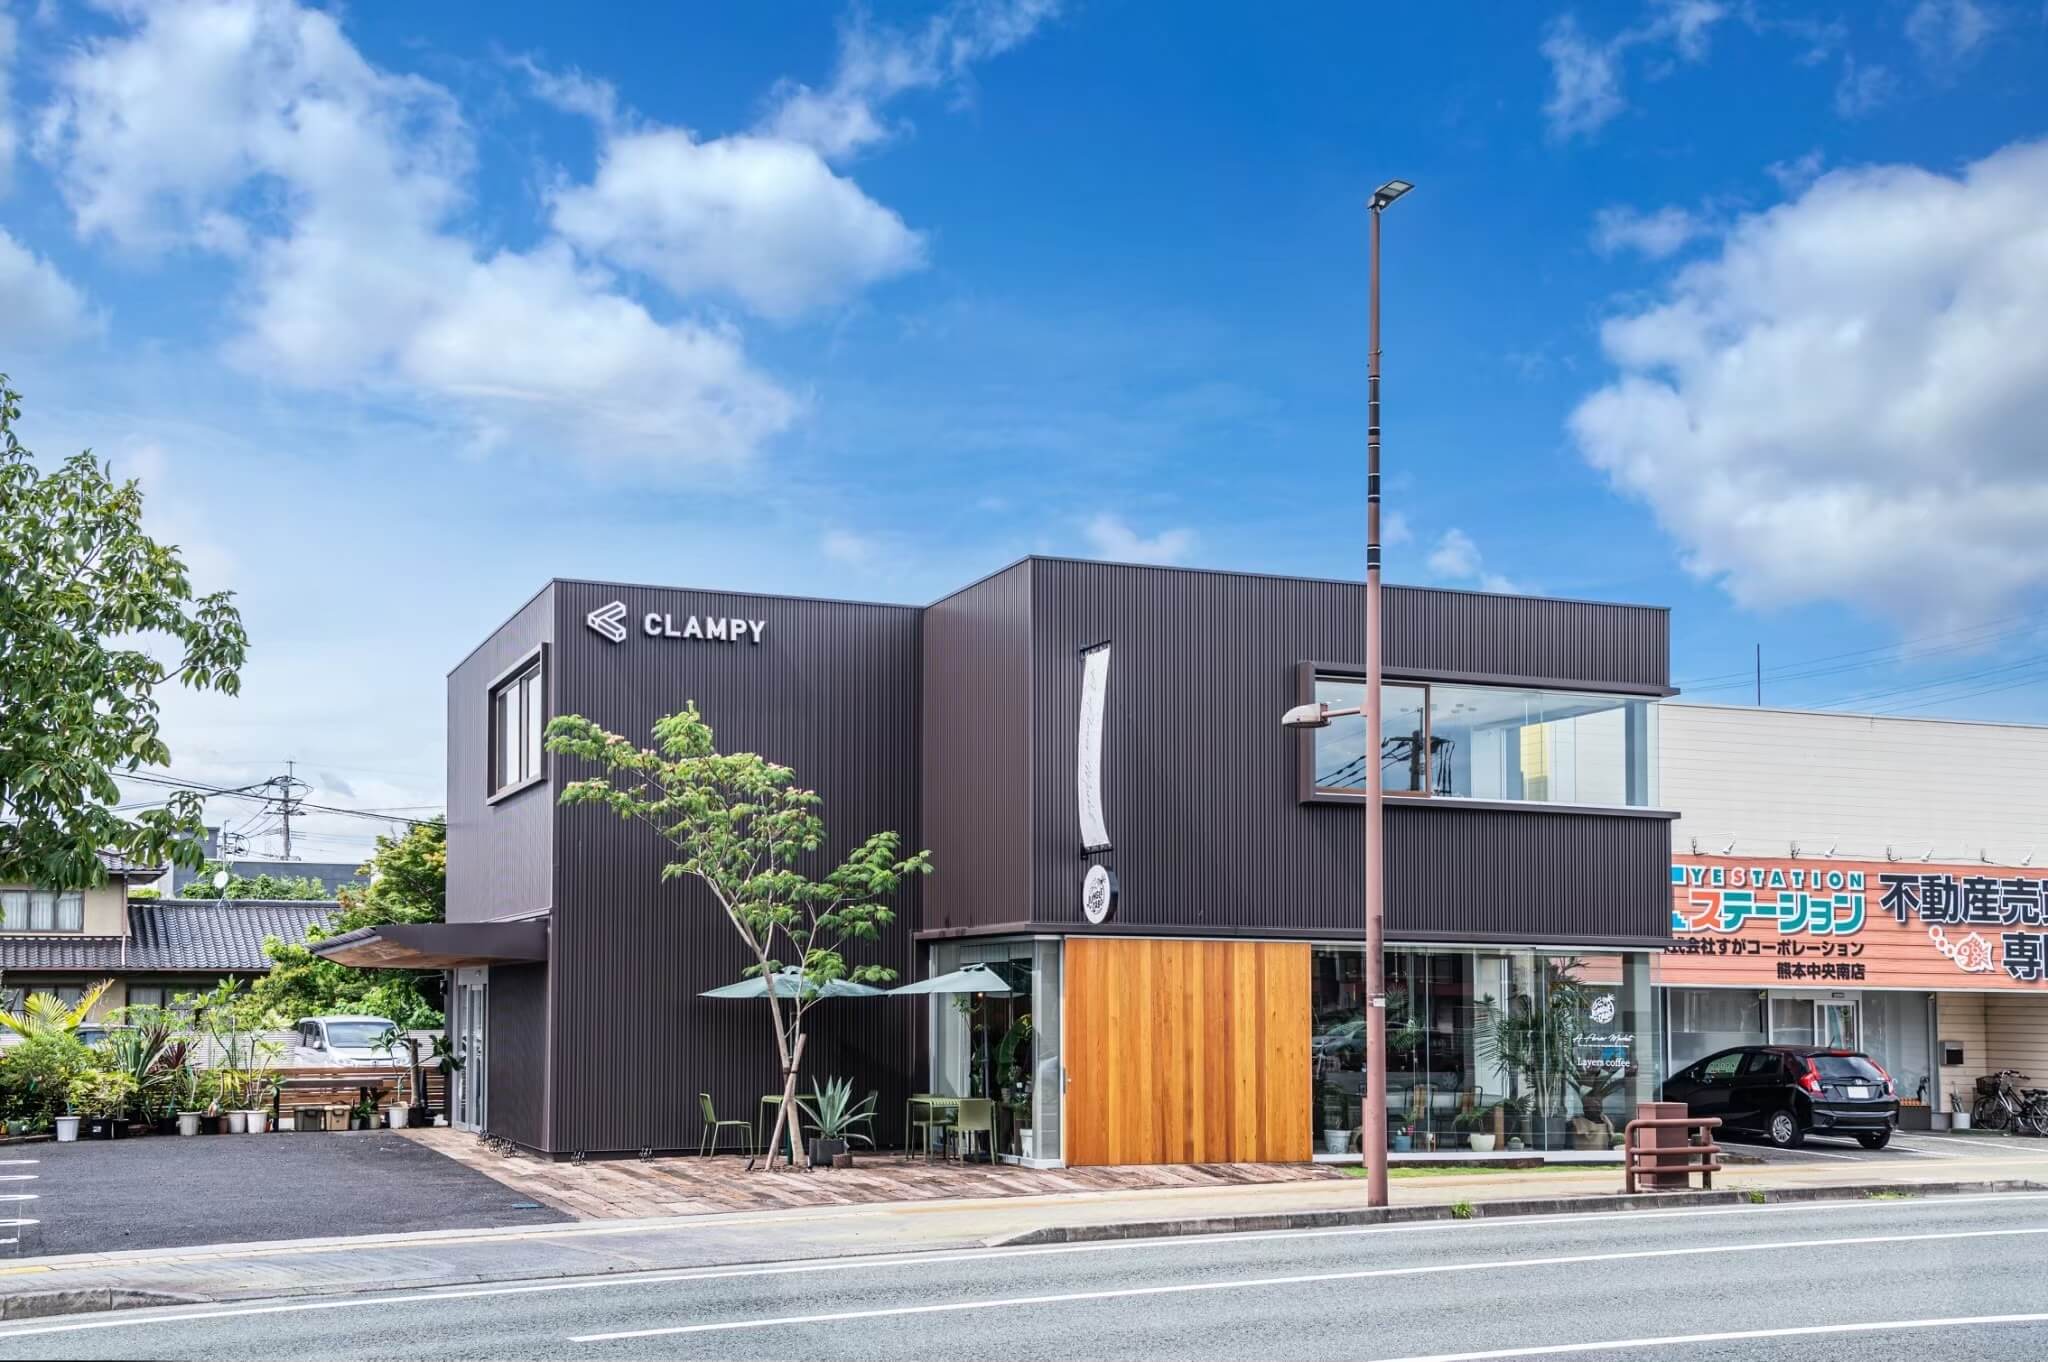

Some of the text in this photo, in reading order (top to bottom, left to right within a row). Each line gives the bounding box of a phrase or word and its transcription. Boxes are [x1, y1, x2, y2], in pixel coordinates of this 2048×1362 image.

[644, 613, 765, 642] CLAMPY
[1691, 866, 1865, 890] YESTATION
[1879, 873, 2048, 926] 不動産売
[1665, 937, 1865, 957] 式会社すがコーポレーション
[2001, 930, 2048, 981] 専
[1776, 962, 1866, 981] 熊本中央南店
[1578, 1057, 1630, 1068] Layers coffee
